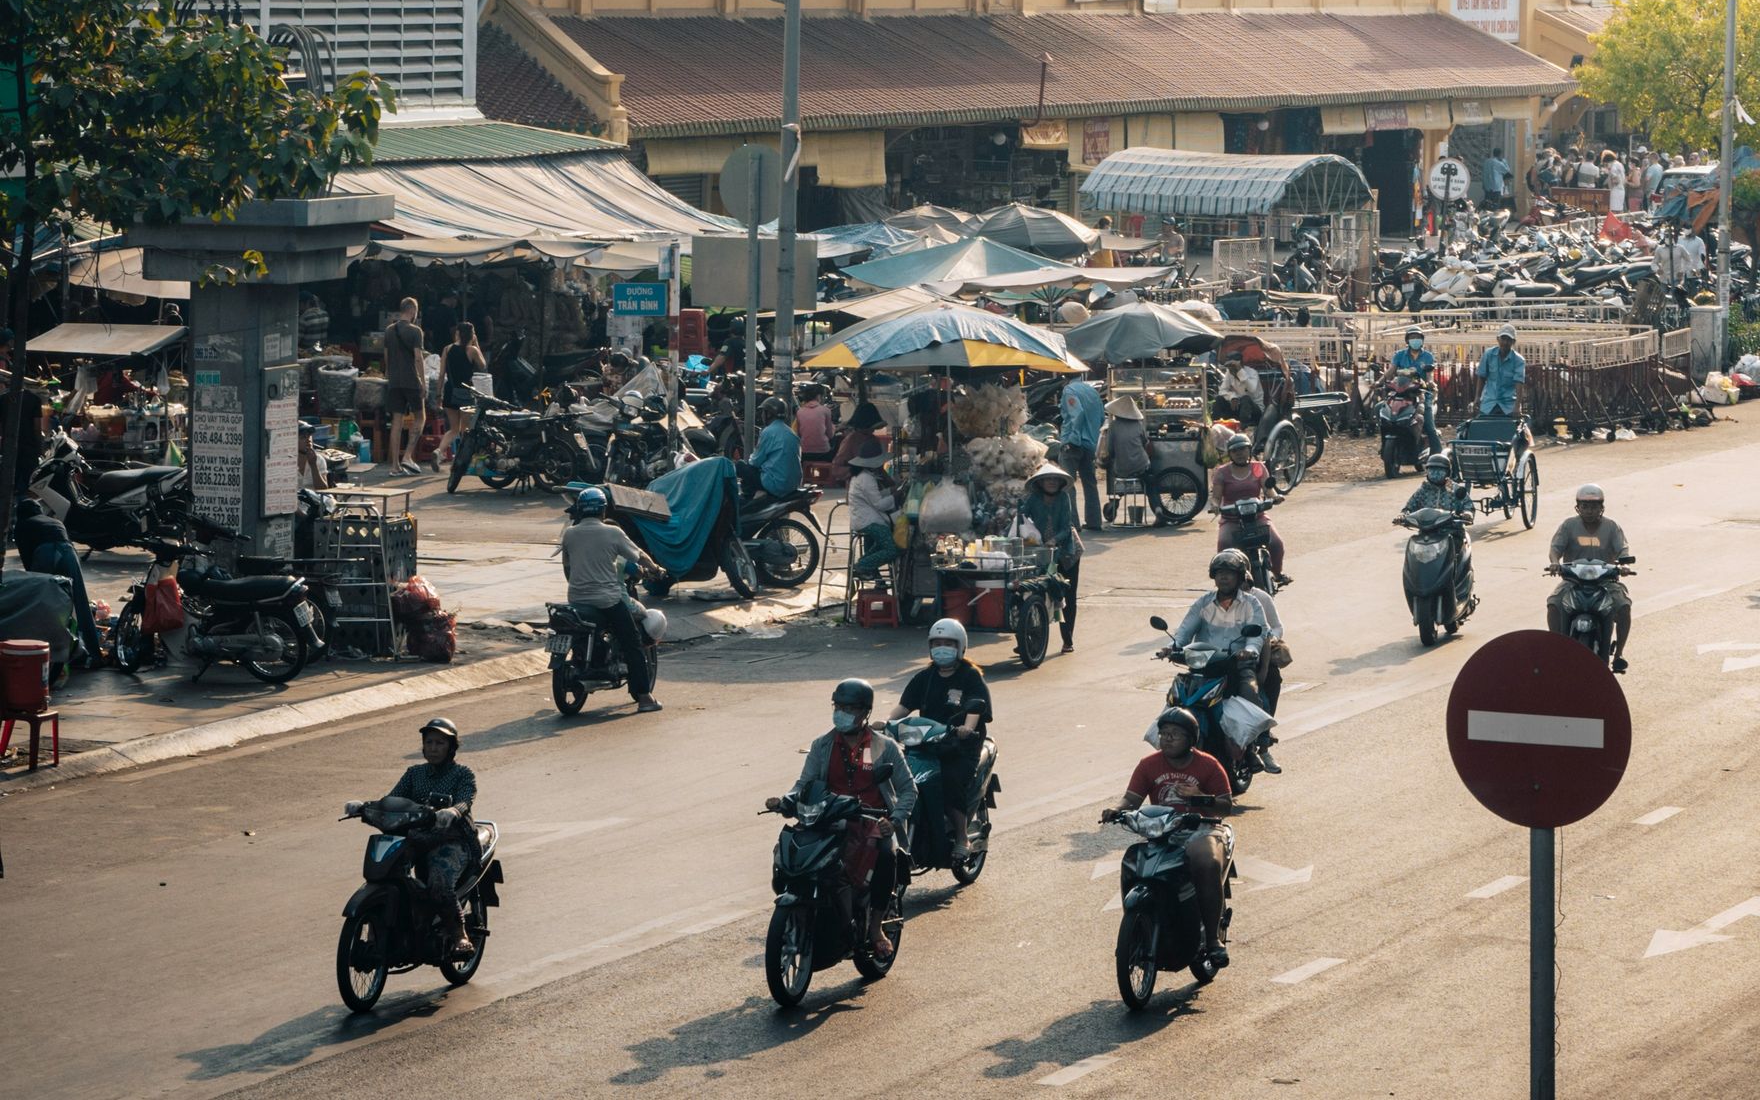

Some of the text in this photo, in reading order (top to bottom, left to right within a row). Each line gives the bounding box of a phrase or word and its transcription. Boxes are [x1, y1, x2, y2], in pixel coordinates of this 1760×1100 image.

[640, 297, 658, 310] BÌNH
[194, 414, 206, 423] CHO
[207, 415, 217, 423] VAY
[194, 431, 243, 445] 036.484.3399
[194, 455, 206, 464] CHO
[207, 456, 217, 465] VAY
[206, 496, 216, 505] VAY
